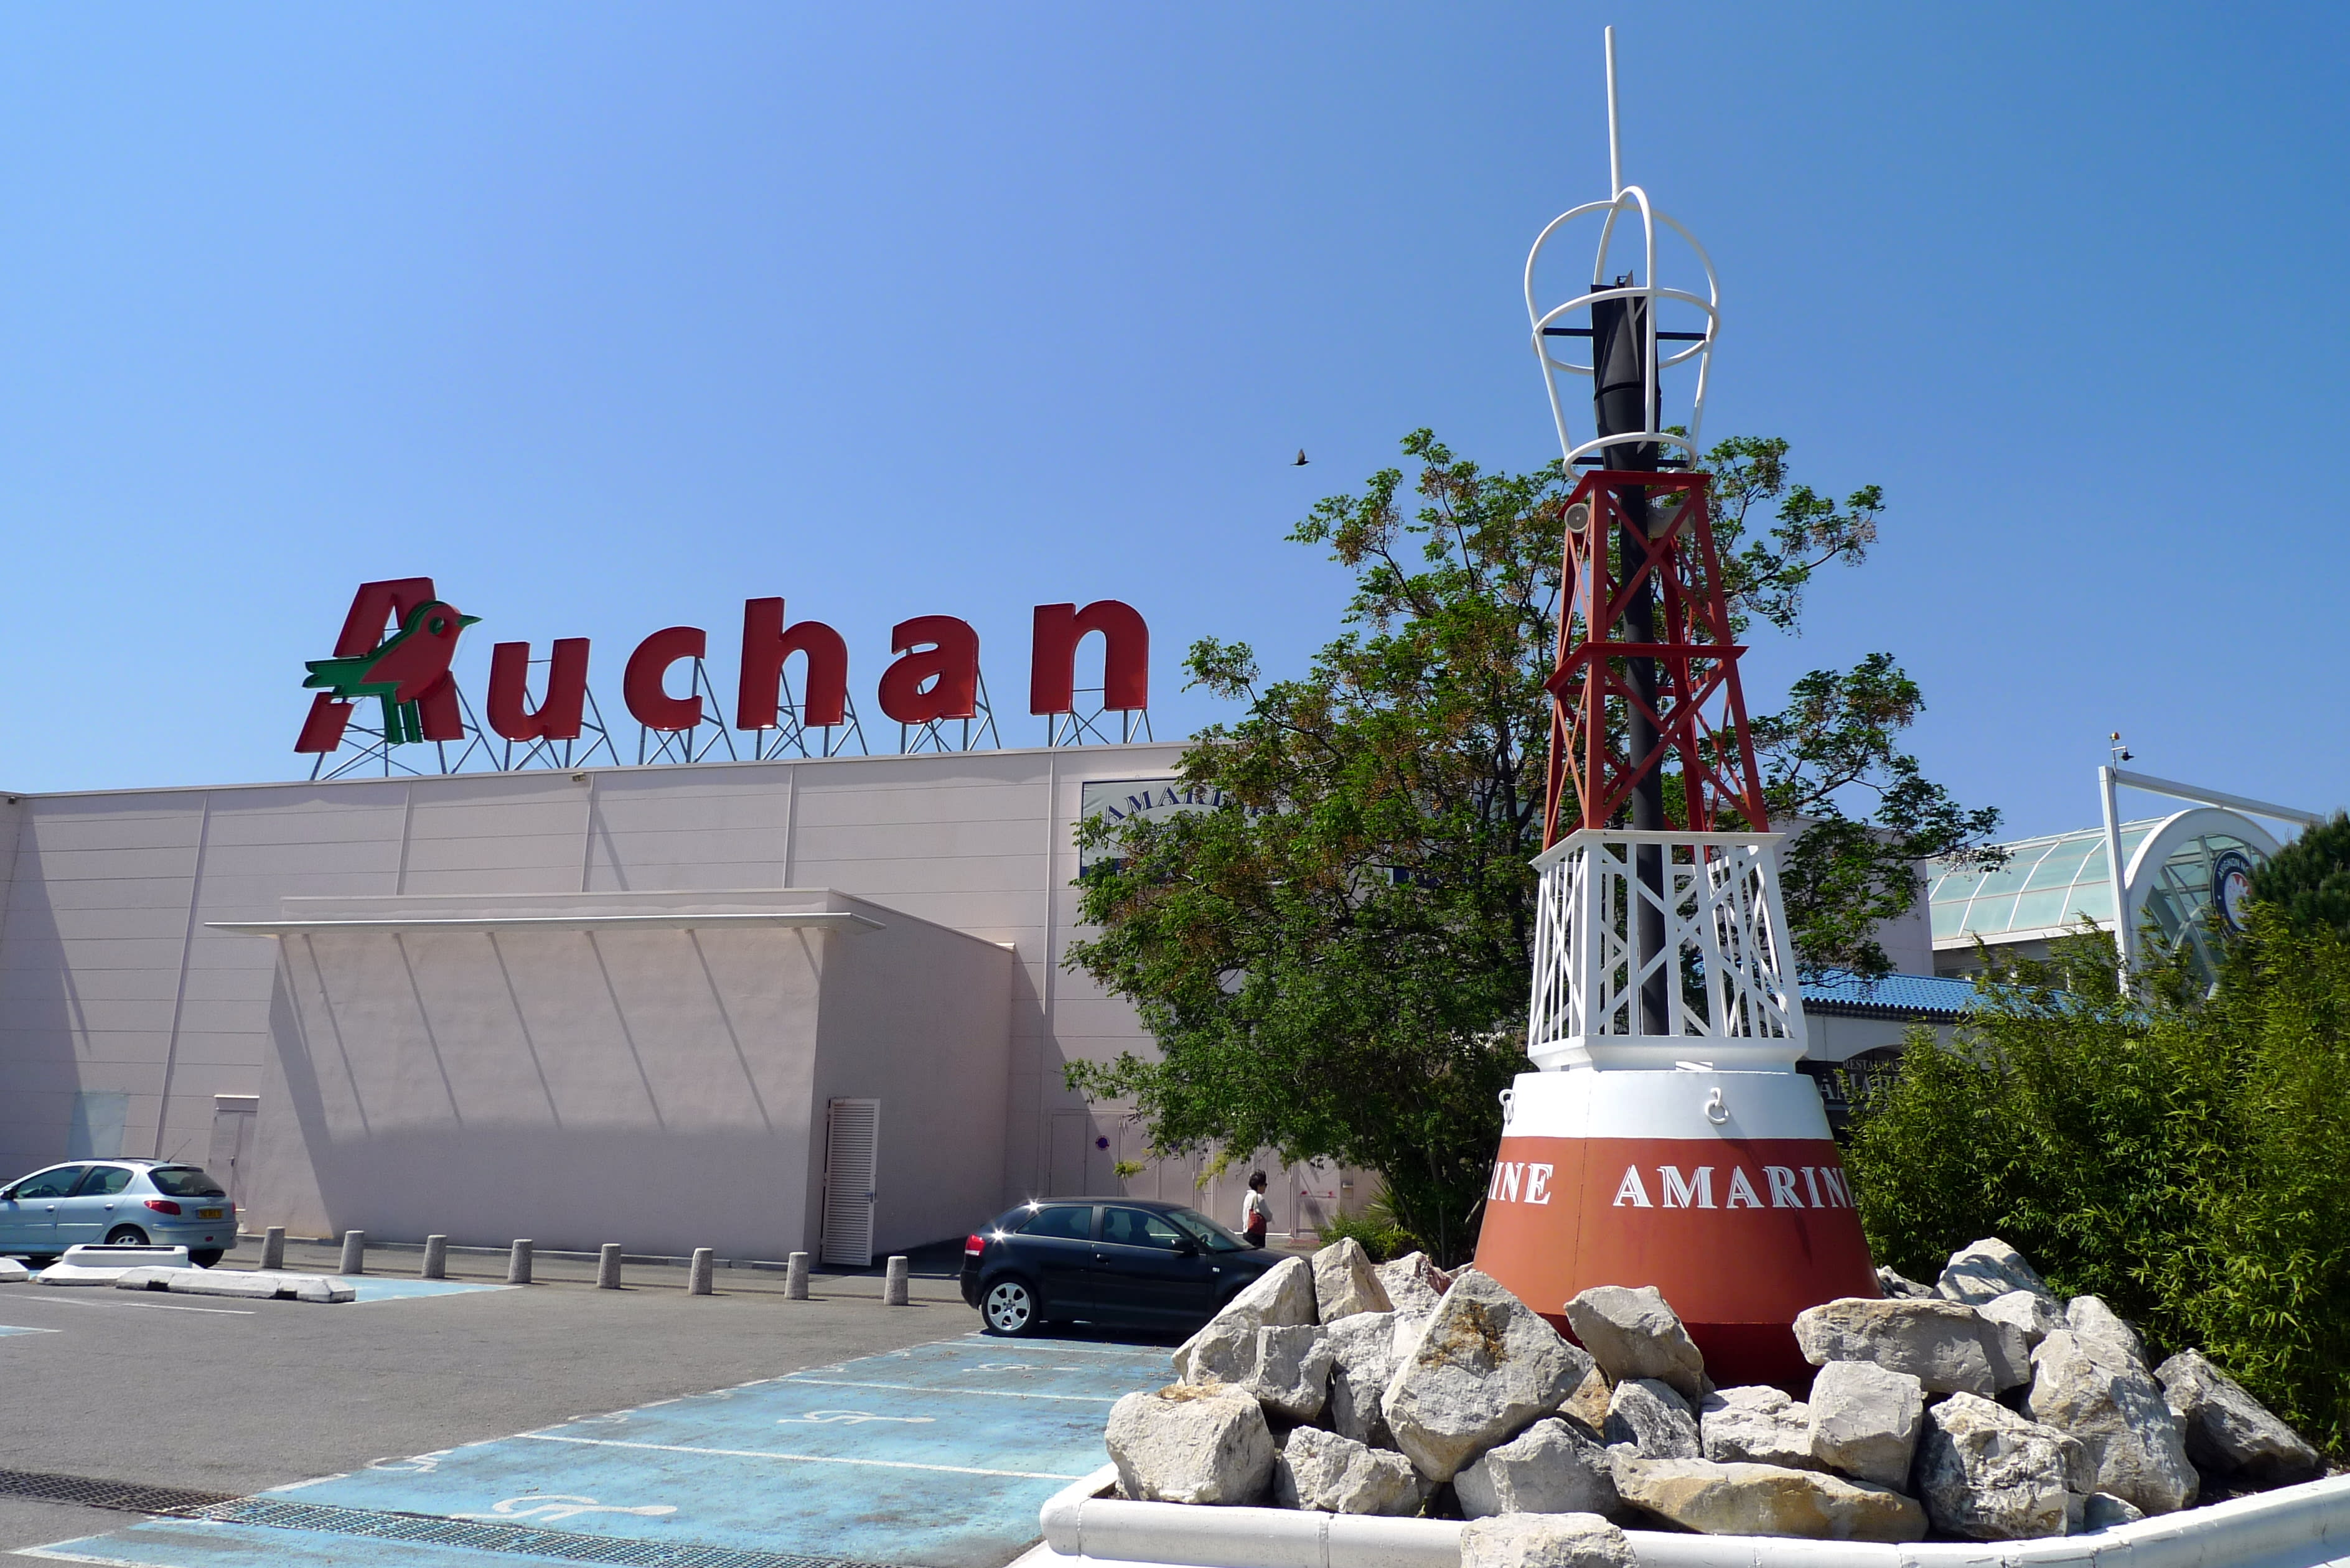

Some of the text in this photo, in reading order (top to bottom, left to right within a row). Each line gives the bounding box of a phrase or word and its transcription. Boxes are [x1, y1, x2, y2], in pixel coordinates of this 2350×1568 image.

[294, 576, 1150, 754] Auchan
[1105, 785, 1262, 826] AMARI
[1487, 1162, 1554, 1205] INE
